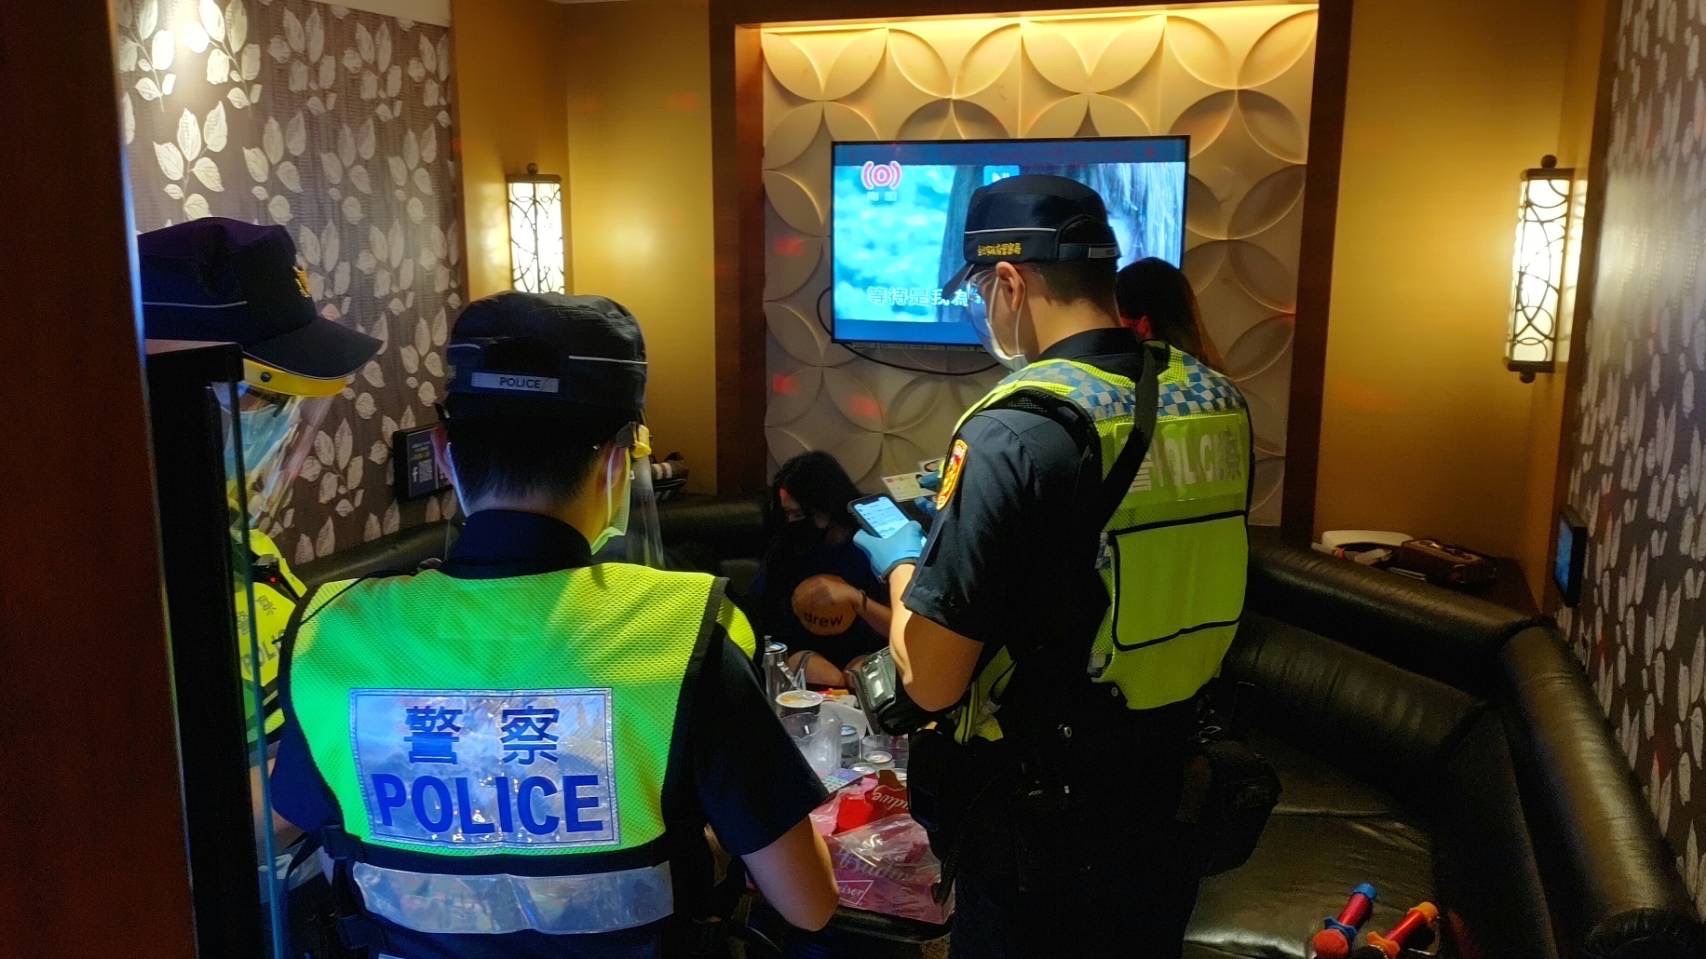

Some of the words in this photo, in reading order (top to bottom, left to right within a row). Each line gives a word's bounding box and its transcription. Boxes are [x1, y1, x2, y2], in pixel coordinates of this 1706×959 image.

[500, 376, 541, 390] POLICE
[804, 612, 843, 627] drew
[404, 705, 560, 765] 警察
[371, 773, 604, 836] POLICE
